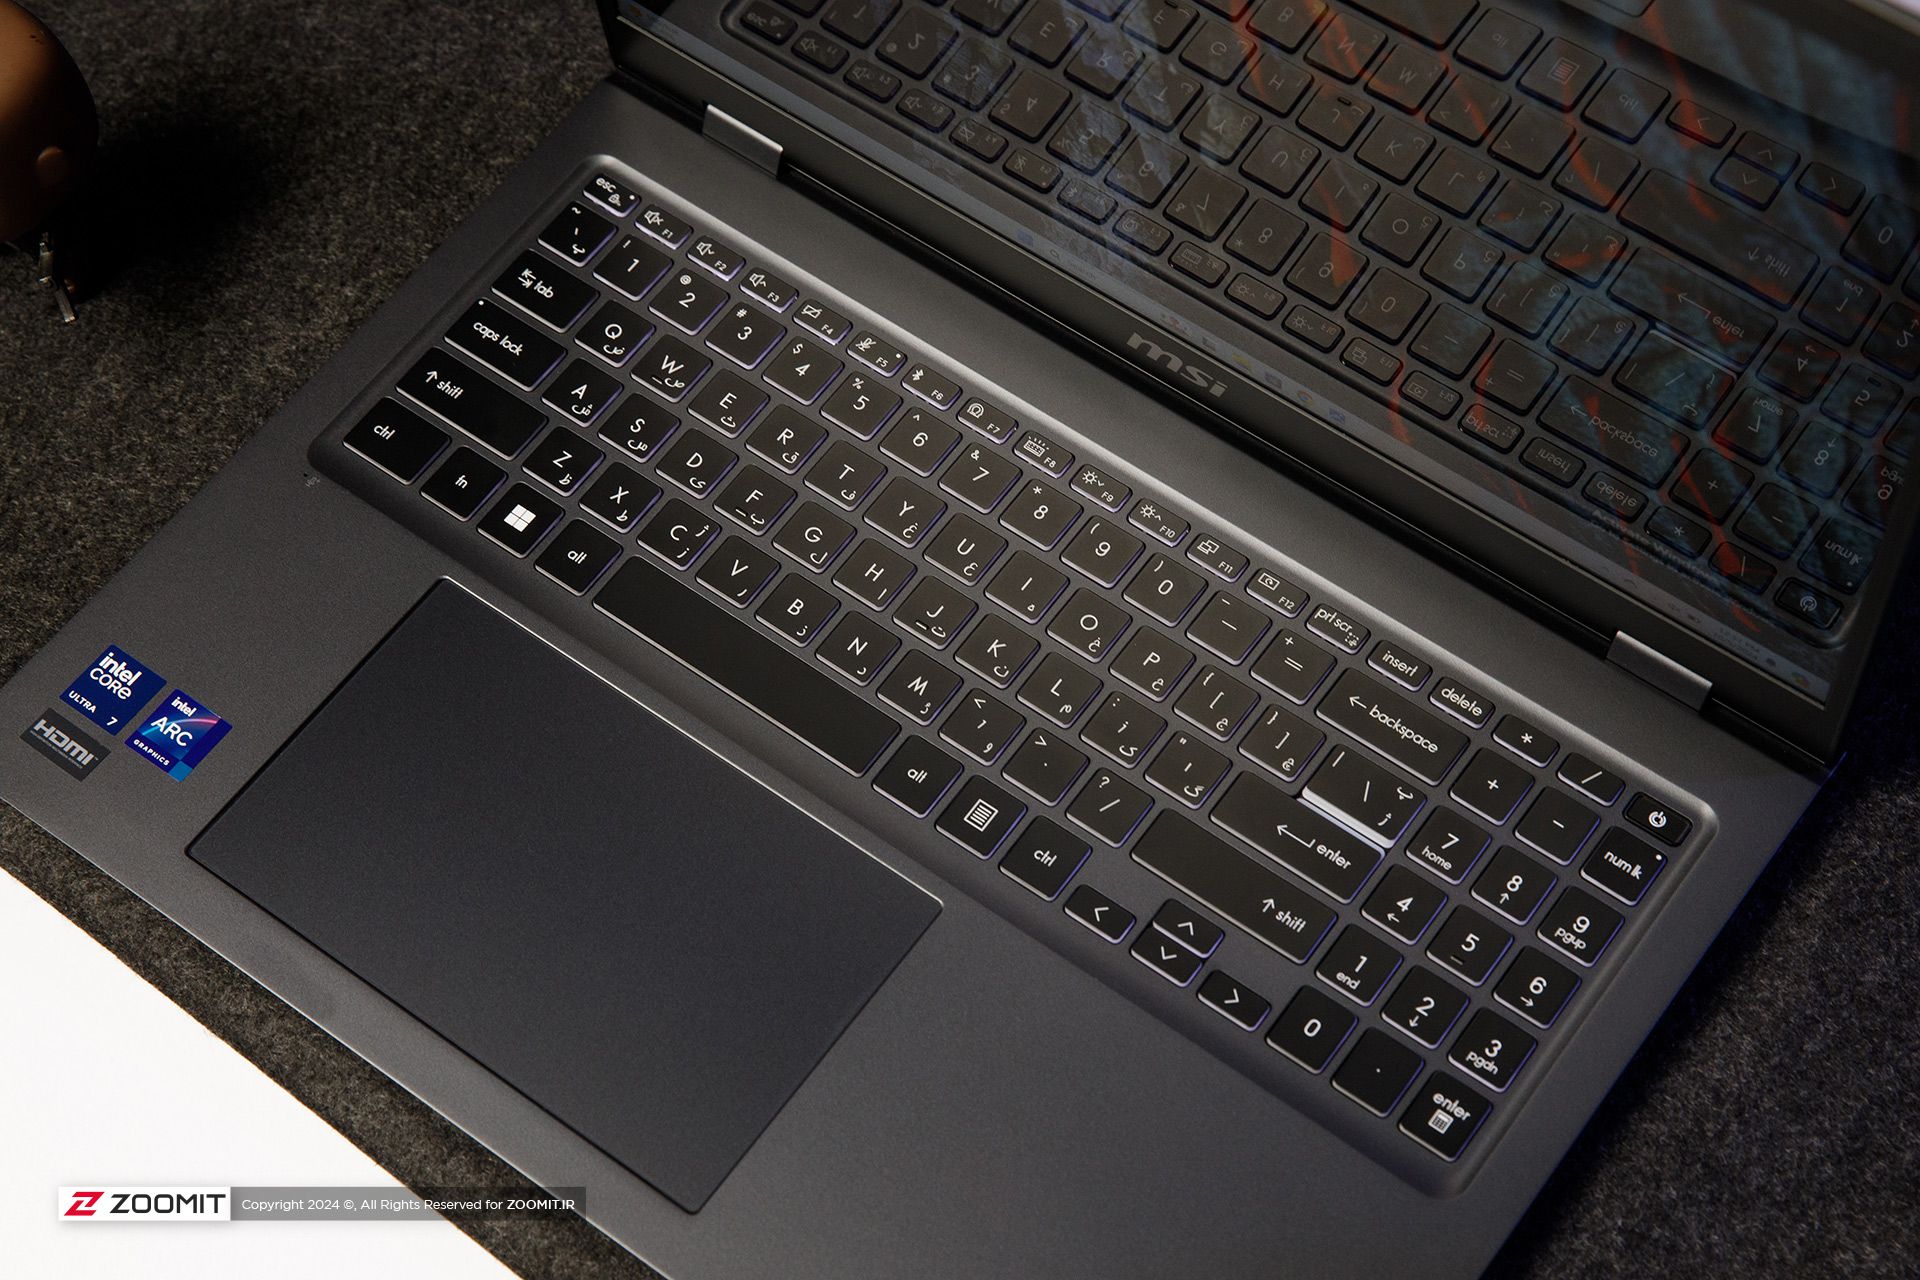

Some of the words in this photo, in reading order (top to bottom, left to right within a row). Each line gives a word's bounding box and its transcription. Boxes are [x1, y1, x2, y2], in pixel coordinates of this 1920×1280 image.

[596, 178, 616, 193] esc
[662, 229, 673, 238] F1
[628, 259, 639, 272] 1
[715, 260, 727, 271] F2
[680, 275, 691, 285] @
[534, 280, 553, 298] tab
[767, 292, 779, 302] F3
[679, 292, 695, 308] 2
[605, 324, 622, 340] Q
[738, 326, 752, 340] 3
[821, 324, 833, 335] F4
[473, 322, 500, 341] caps
[499, 335, 523, 356] lock
[661, 355, 684, 374] W
[795, 364, 810, 376] 4
[876, 357, 888, 367] F5
[1127, 332, 1228, 398] msi
[437, 381, 463, 399] shift
[571, 384, 587, 399] A
[852, 378, 864, 389] %
[719, 393, 737, 409] E
[853, 395, 870, 410] 5
[931, 390, 944, 400] F6
[374, 425, 395, 440] ctrl
[630, 418, 645, 433] S
[987, 423, 1000, 434] F7
[777, 428, 794, 445] R
[913, 432, 928, 447] 6
[553, 451, 572, 468] Z
[686, 452, 703, 467] D
[1044, 457, 1056, 468] F8
[839, 464, 854, 479] T
[972, 467, 989, 481] 7
[455, 475, 467, 488] fn
[610, 486, 629, 504] X
[745, 490, 763, 503] F
[1101, 491, 1114, 502] F9
[899, 501, 914, 516] Y
[1034, 505, 1048, 519] 8
[670, 525, 688, 541] C
[805, 527, 823, 542] G
[1159, 525, 1175, 538] F10
[957, 538, 975, 555] U
[1095, 542, 1110, 556] 9
[568, 551, 587, 564] alt
[731, 559, 748, 576] V
[865, 563, 884, 581] H
[1218, 561, 1233, 574] F11
[1158, 580, 1173, 595] 0
[787, 598, 804, 615] B
[1278, 596, 1295, 610] F12
[926, 605, 944, 618] J
[1080, 614, 1098, 630] O
[847, 637, 868, 655] N
[987, 639, 1006, 657] K
[1143, 652, 1160, 666] P
[1382, 650, 1418, 676] insert
[99, 652, 142, 687] intel
[907, 676, 928, 696] M
[1051, 679, 1062, 696] L
[69, 690, 97, 713] ULTRA
[171, 696, 197, 717] intel
[1441, 688, 1482, 716] delete
[106, 716, 118, 727] 7
[1369, 704, 1440, 755] backspace
[151, 716, 193, 747] ARC
[33, 719, 94, 766] HDMI
[134, 738, 170, 766] GRAPHICS
[908, 769, 927, 783] alt
[1441, 833, 1459, 849] 7
[1034, 850, 1057, 867] ctrl
[1317, 845, 1351, 869] enter
[1422, 846, 1452, 870] home
[1507, 875, 1523, 892] 8
[1396, 897, 1413, 912] 4
[1276, 911, 1306, 932] shift
[1573, 916, 1590, 933] 9
[1461, 933, 1479, 951] 5
[1554, 927, 1586, 949] pgup
[1355, 956, 1367, 972] 1
[1336, 972, 1360, 989] end
[1529, 977, 1547, 994] 6
[1416, 997, 1435, 1016] 2
[1304, 1019, 1321, 1037] 0
[1485, 1040, 1502, 1057] 3
[1466, 1051, 1498, 1074] pgdn
[1433, 1093, 1470, 1120] enter
